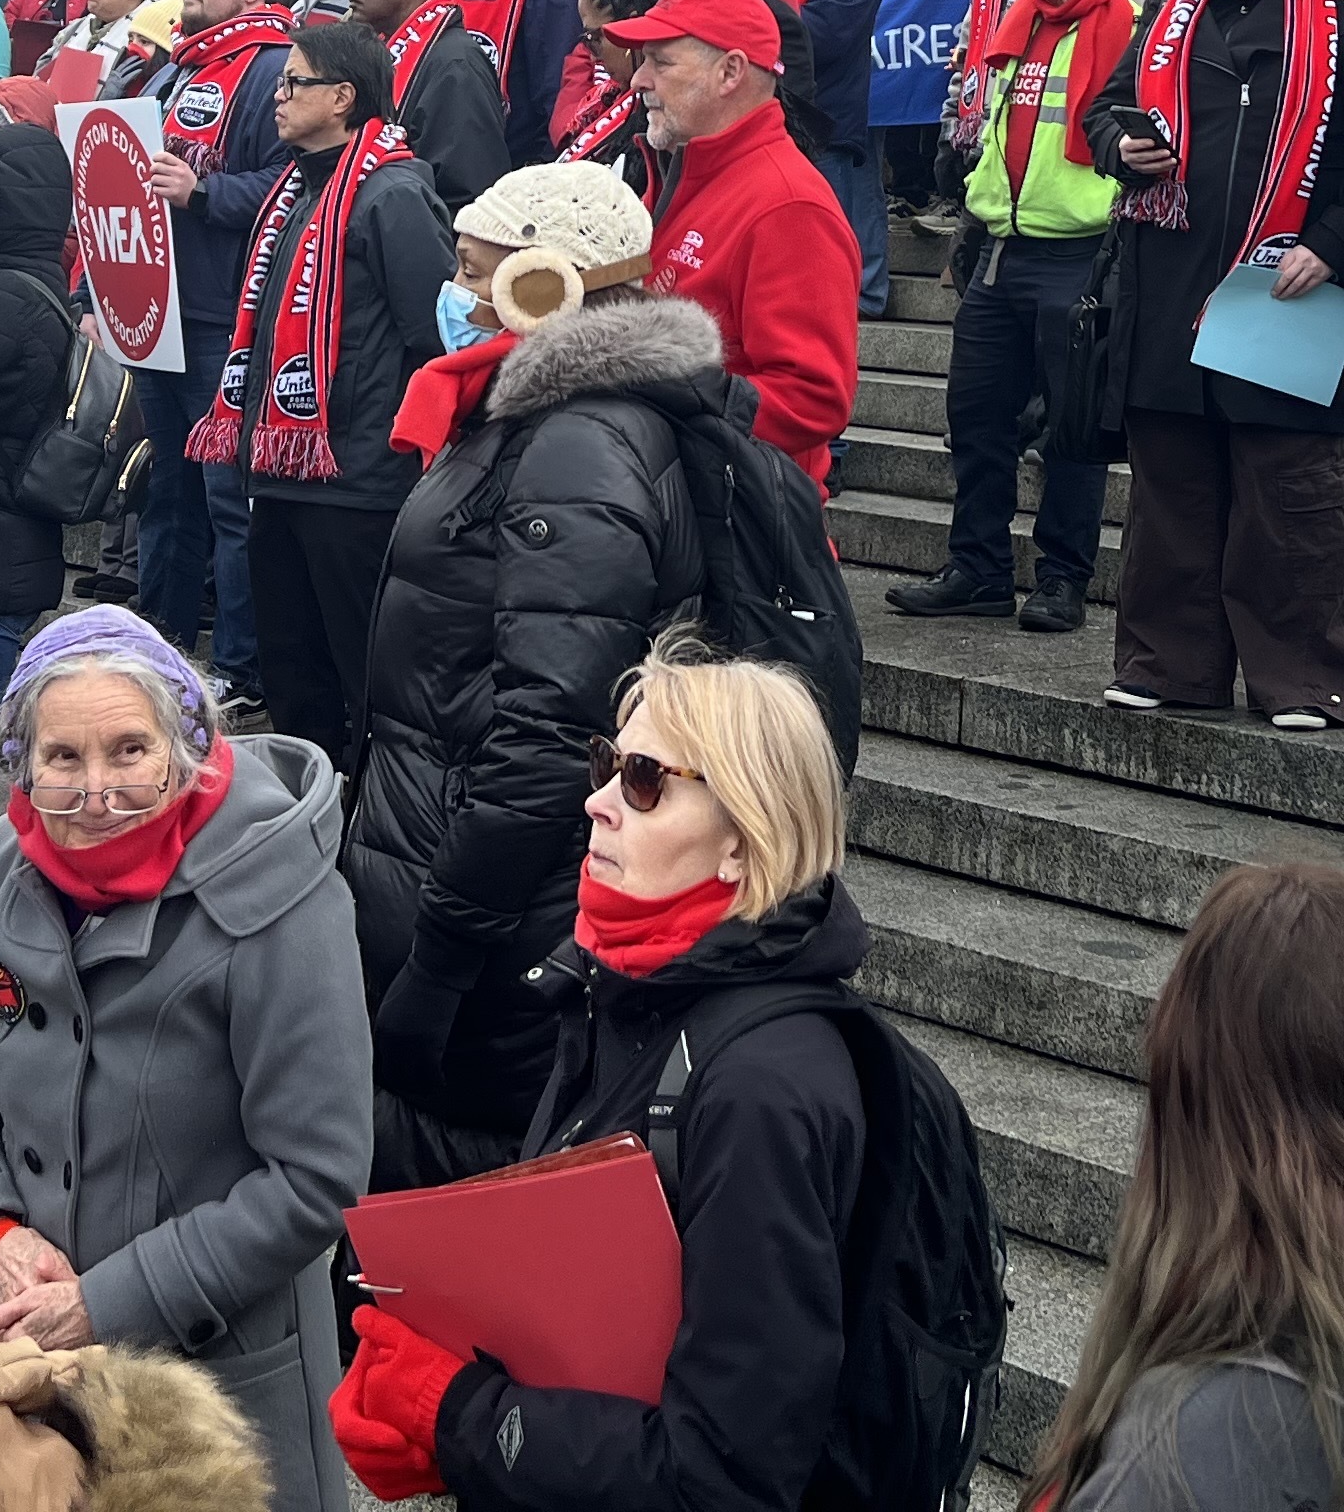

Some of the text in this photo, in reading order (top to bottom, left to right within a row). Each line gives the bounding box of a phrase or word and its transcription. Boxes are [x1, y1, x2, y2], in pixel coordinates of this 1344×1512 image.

[77, 122, 166, 268] WASHINGTON EDUCATION
[88, 205, 153, 266] WEA
[102, 296, 160, 348] ASSOCIATION
